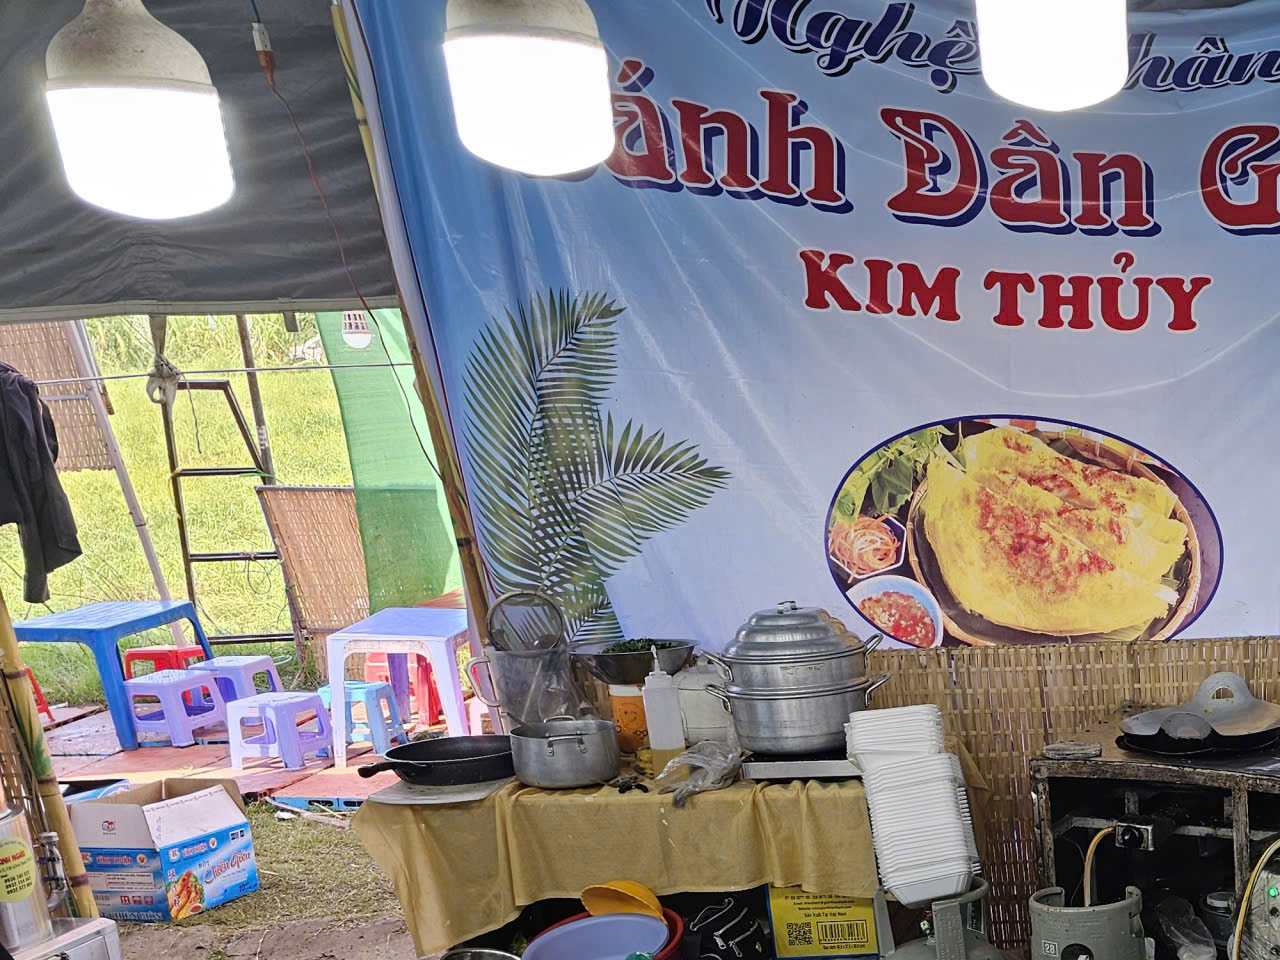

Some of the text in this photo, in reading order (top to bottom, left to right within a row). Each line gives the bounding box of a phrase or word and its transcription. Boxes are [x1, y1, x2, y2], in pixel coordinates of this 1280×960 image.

[602, 58, 854, 214] ánh
[798, 248, 1213, 332] KIM THỦY
